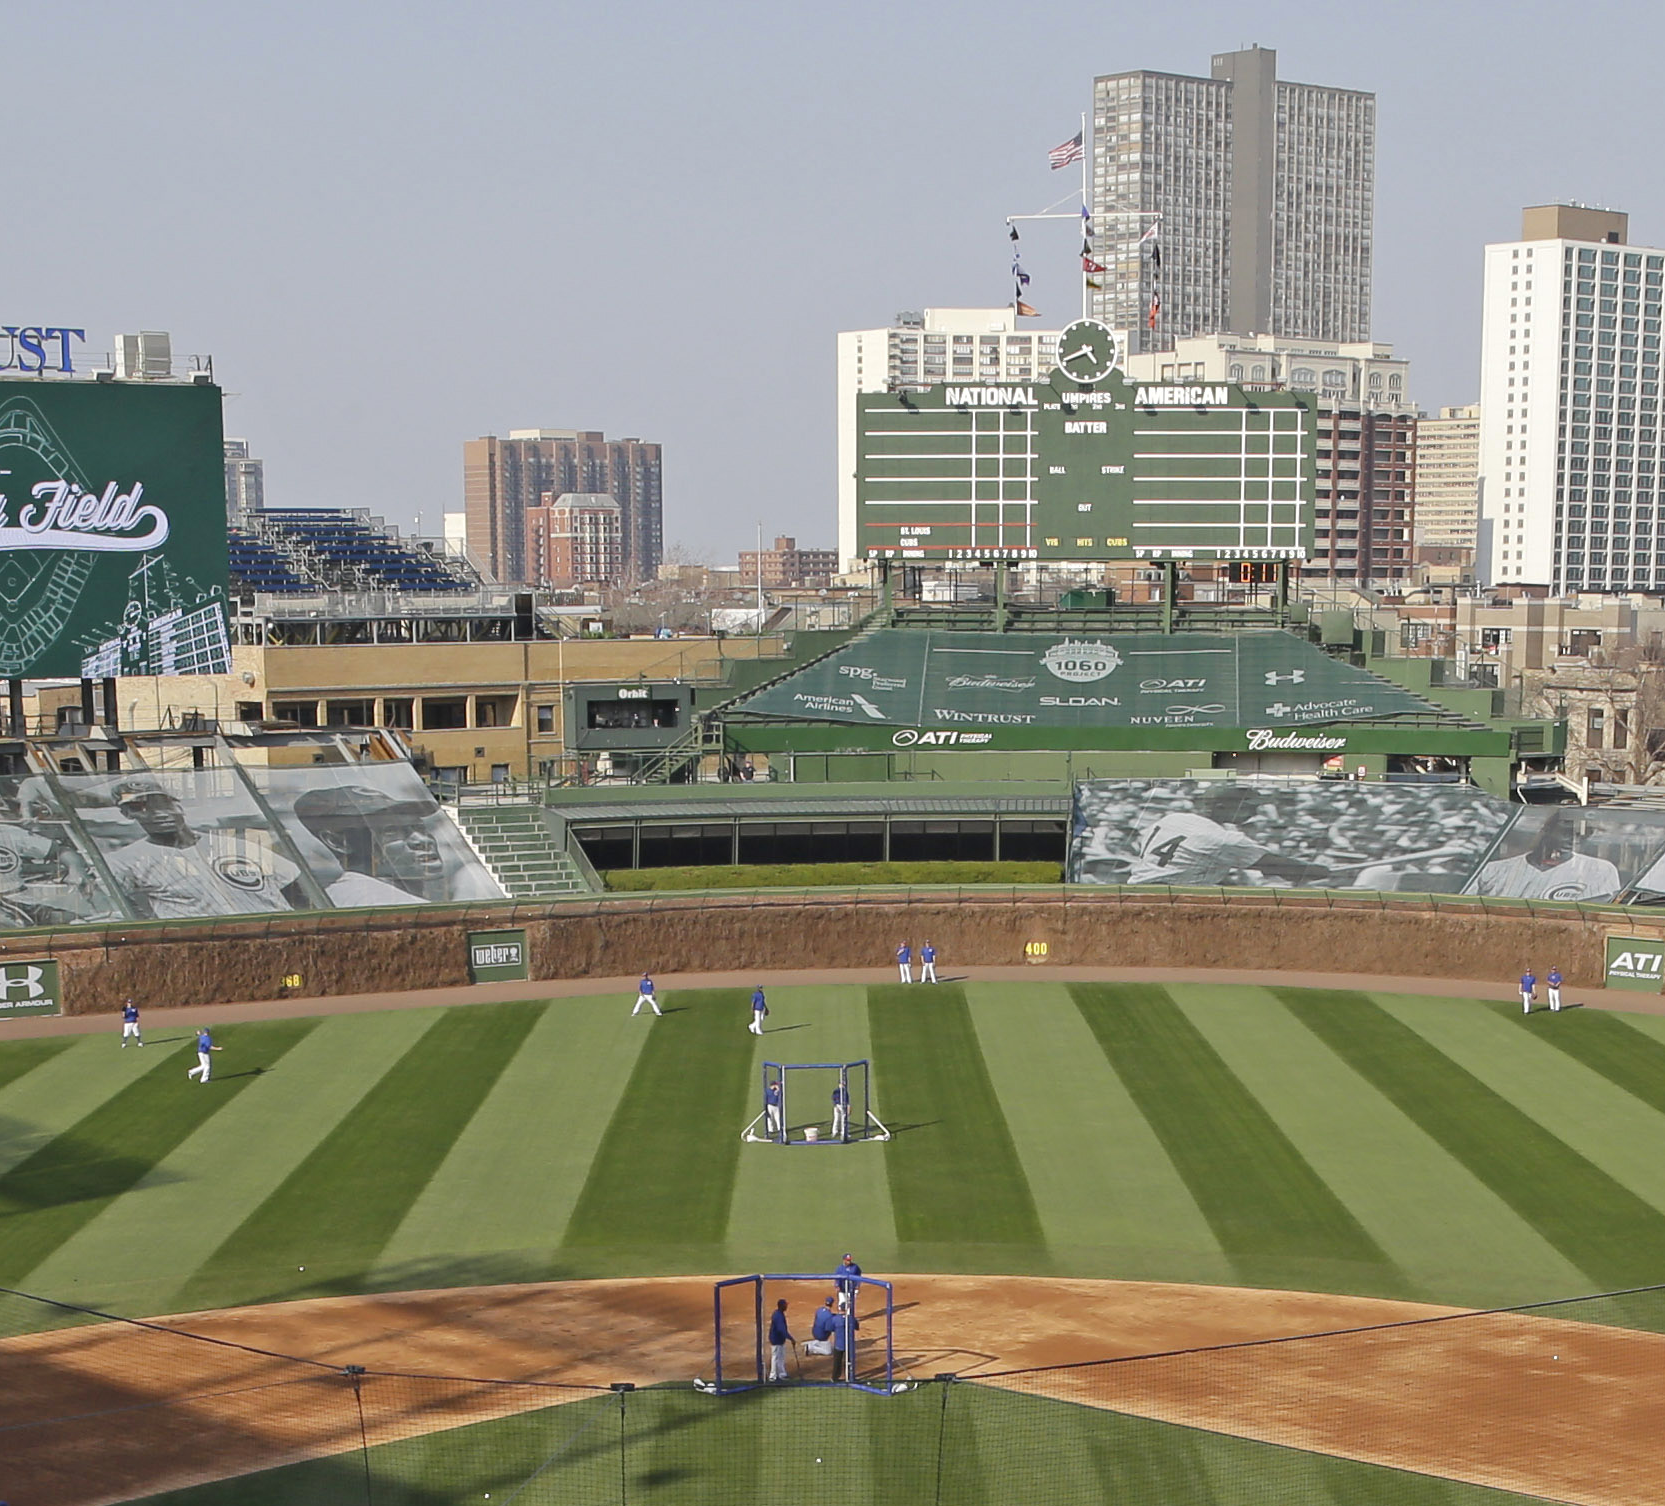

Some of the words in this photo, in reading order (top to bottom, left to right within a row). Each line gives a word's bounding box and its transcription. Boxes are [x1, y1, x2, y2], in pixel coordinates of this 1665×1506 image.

[945, 387, 1038, 405] NATIONAL
[1062, 392, 1111, 404] UMPIRES
[1135, 386, 1228, 405] AMERICAN
[1064, 421, 1107, 434] BATTER
[1049, 466, 1066, 474] BALL
[1101, 466, 1125, 474] STRIKE
[20, 481, 144, 533] Field
[1078, 503, 1092, 512] OUT
[1055, 660, 1107, 672] 1060
[1166, 678, 1208, 688] ATI
[618, 688, 649, 699] Orbit
[794, 693, 854, 706] American
[805, 702, 853, 713] Airlines
[1295, 699, 1357, 712] Advocate
[1295, 706, 1345, 720] Health
[1347, 704, 1374, 715] Care
[934, 709, 1035, 724] WINTRUST
[1130, 716, 1194, 724] NUVEEN
[917, 731, 959, 745] ATI
[1246, 730, 1347, 750] Budweiser
[476, 945, 509, 965] weber
[1025, 942, 1048, 956] 400
[1610, 952, 1663, 972] ATI
[15, 999, 53, 1009] ARMOUR
